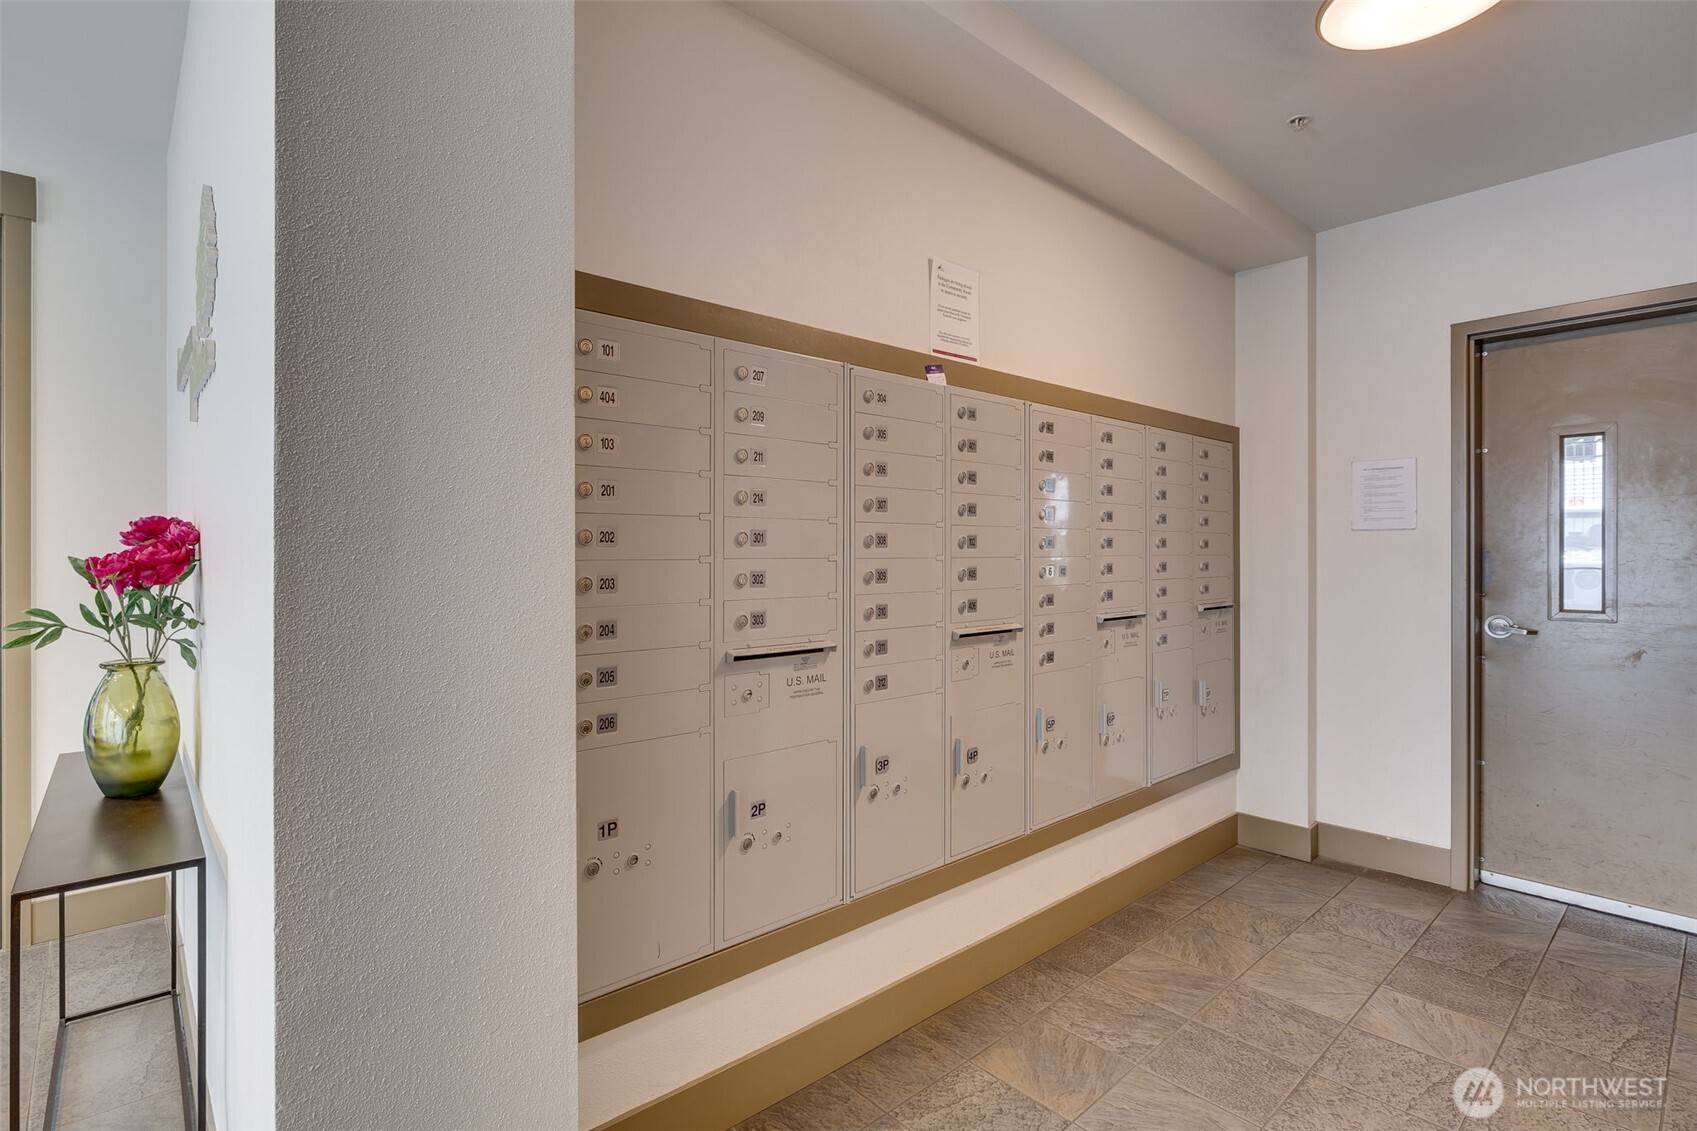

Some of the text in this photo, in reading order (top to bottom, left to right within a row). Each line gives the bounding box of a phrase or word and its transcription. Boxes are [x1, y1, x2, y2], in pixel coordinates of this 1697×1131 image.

[601, 344, 614, 357] 101
[752, 370, 764, 381] 207
[599, 391, 615, 404] 404
[877, 393, 887, 403] 304
[752, 411, 764, 422] 209
[877, 429, 887, 439] 305
[600, 437, 615, 450] 103
[753, 451, 763, 462] 211
[877, 465, 886, 475] 306
[601, 484, 615, 496] 201
[752, 493, 764, 503] 214
[877, 500, 886, 510] 307
[599, 531, 615, 543] 202
[752, 533, 764, 543] 301
[877, 536, 886, 545] 308
[877, 571, 886, 581] 309
[1047, 567, 1052, 576] 6
[599, 578, 615, 590] 203
[751, 574, 764, 584] 302
[877, 607, 887, 617] 310
[752, 614, 764, 625] 303
[599, 624, 615, 636] 204
[877, 642, 886, 653] 311
[1002, 649, 1015, 657] MAIL
[599, 671, 615, 683] 205
[786, 673, 826, 687] U.S. MAIL
[877, 677, 886, 688] 312
[599, 717, 615, 730] 206
[968, 750, 978, 760] 4P
[877, 759, 889, 771] 3P
[751, 802, 766, 818] 2P
[599, 821, 618, 838] 1P
